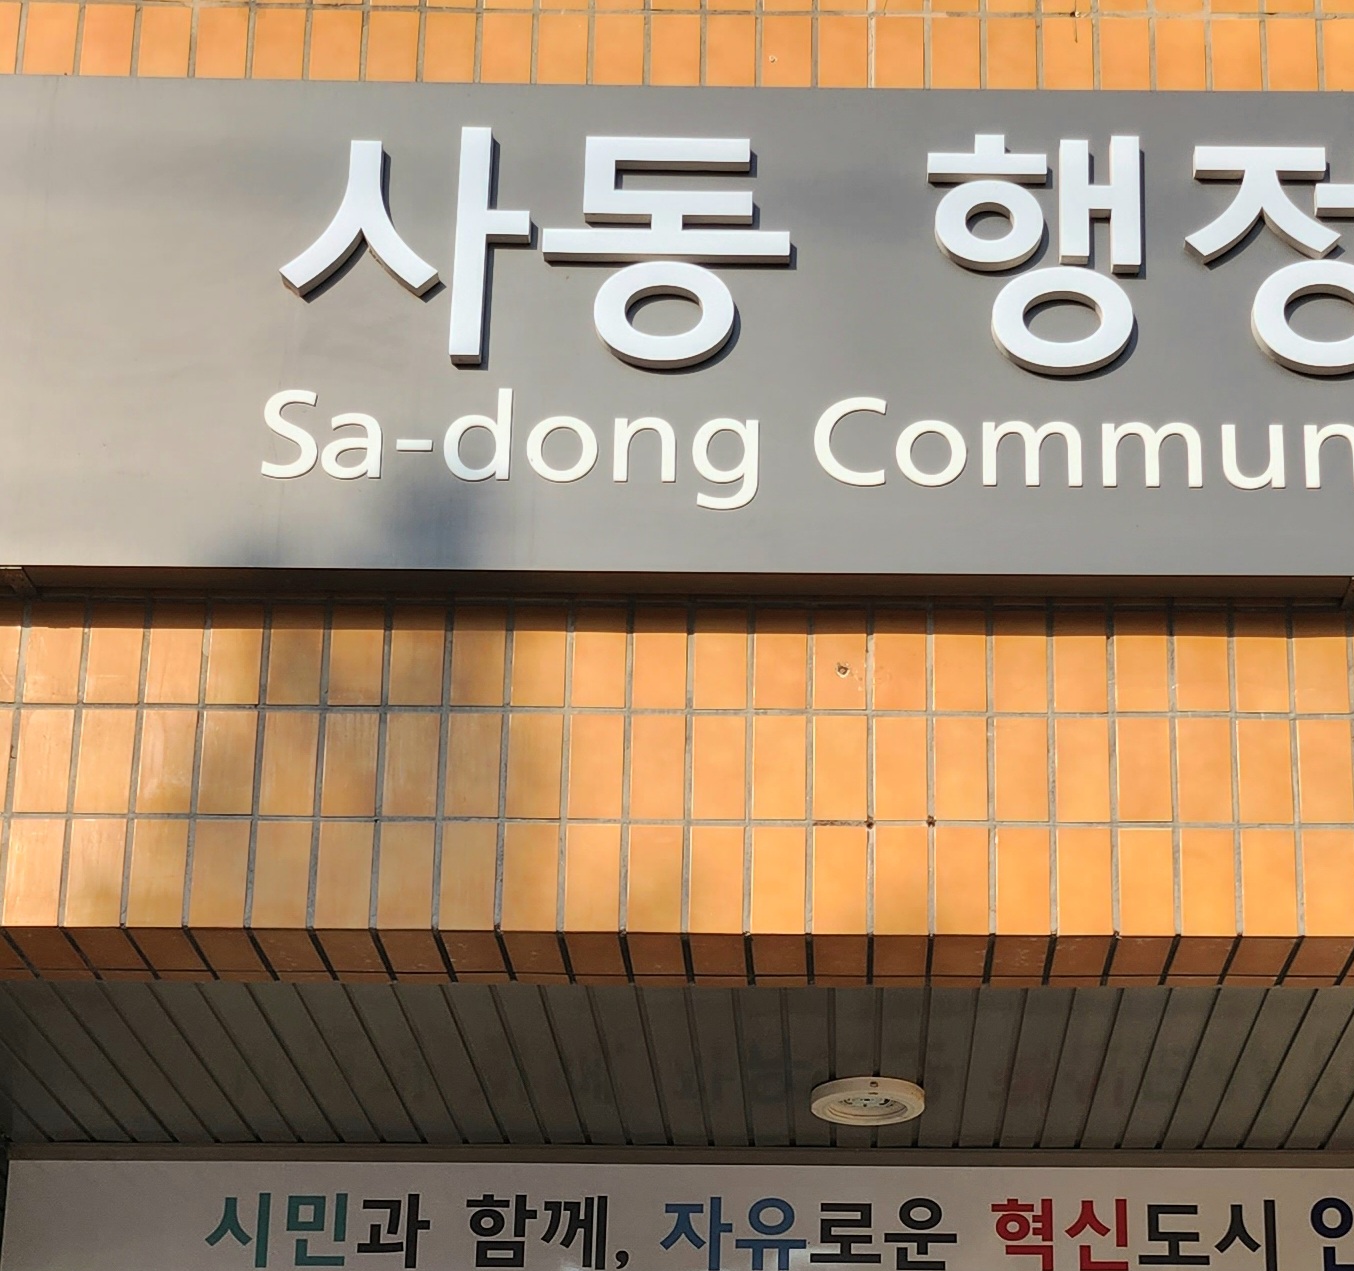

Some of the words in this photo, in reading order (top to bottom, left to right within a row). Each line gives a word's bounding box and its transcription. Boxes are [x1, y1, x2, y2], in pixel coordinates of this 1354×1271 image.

[279, 126, 794, 370] 사동
[259, 386, 762, 511] Sa-dong
[205, 1192, 431, 1269] 시민과
[465, 1194, 629, 1270] 함께,
[658, 1196, 958, 1271] 자유로운
